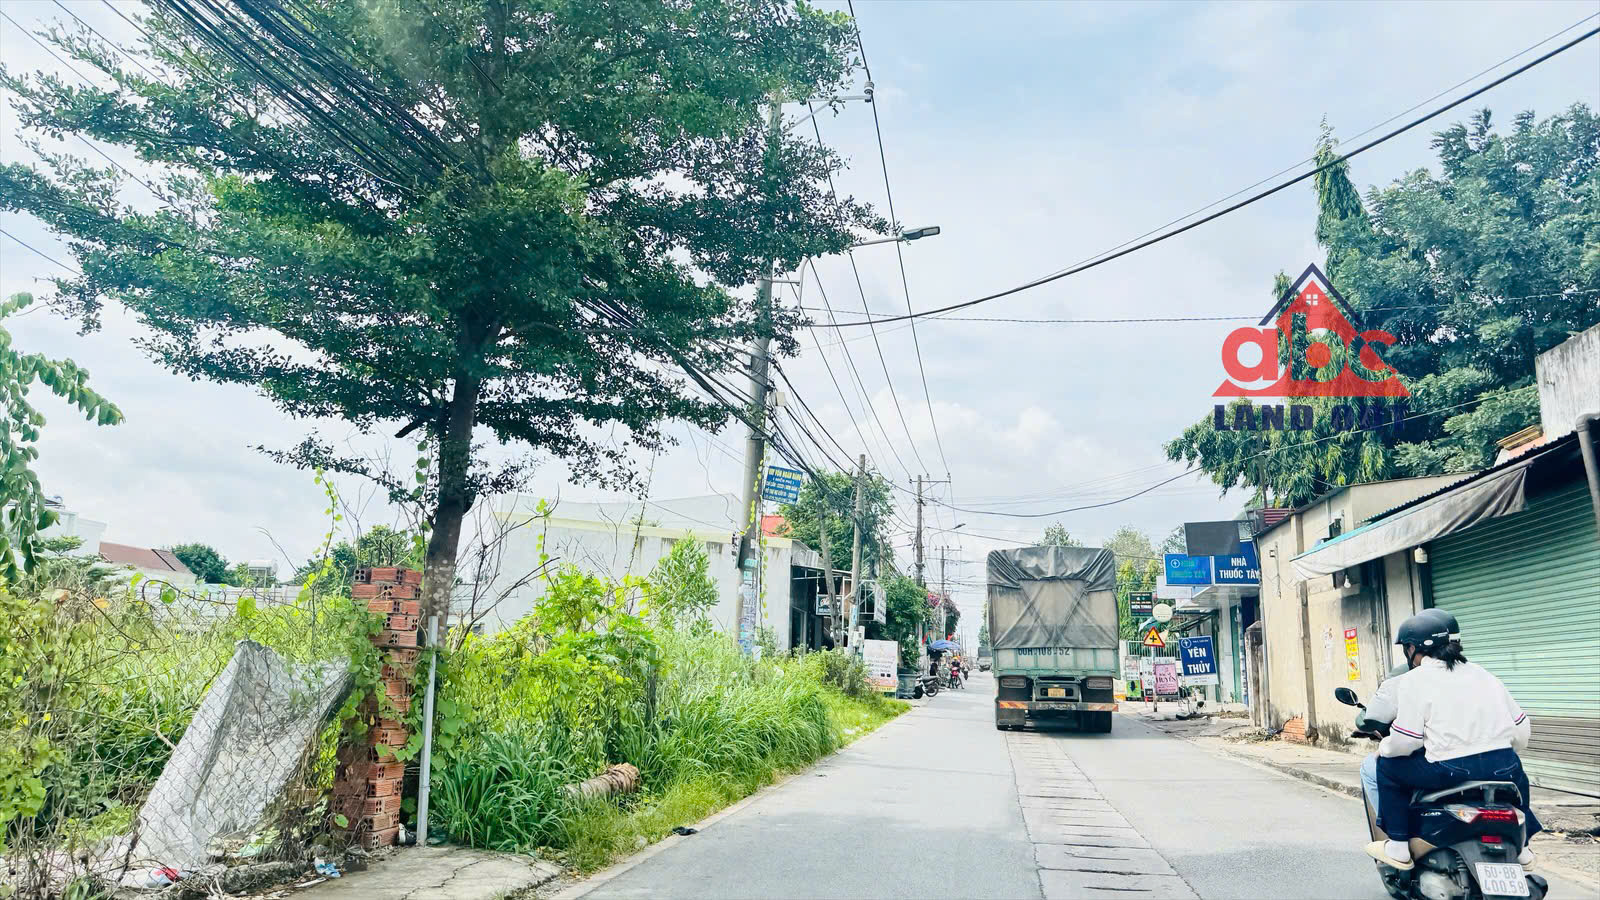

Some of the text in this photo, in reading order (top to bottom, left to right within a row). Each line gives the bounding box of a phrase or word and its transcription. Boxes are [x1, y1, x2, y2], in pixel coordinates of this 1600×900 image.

[1231, 556, 1247, 567] NHÀ
[1219, 567, 1260, 579] THUỐC TÂY
[1187, 646, 1207, 658] YÊN
[1187, 660, 1211, 674] THỦY
